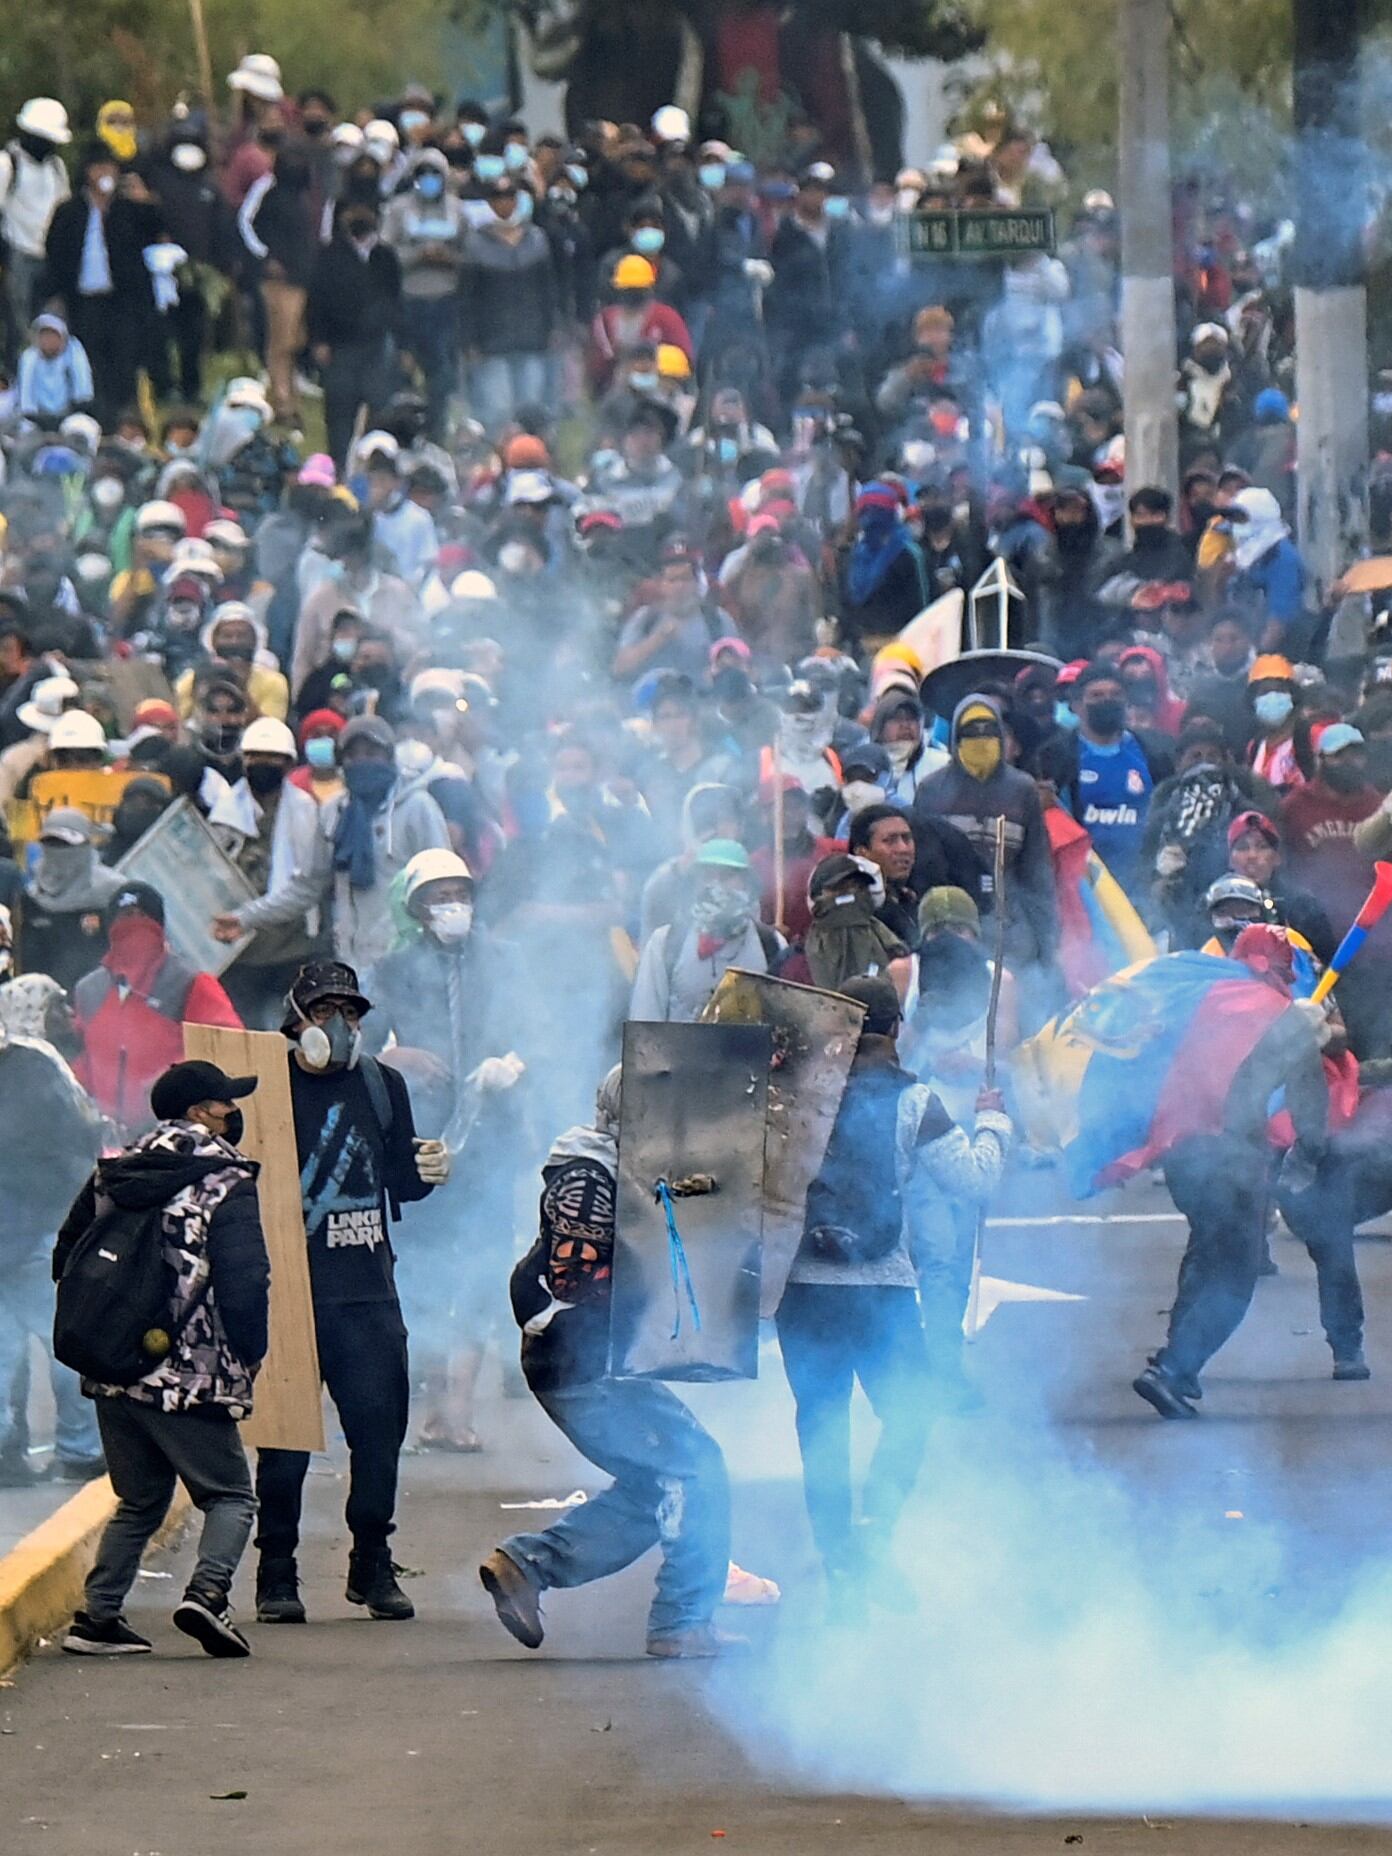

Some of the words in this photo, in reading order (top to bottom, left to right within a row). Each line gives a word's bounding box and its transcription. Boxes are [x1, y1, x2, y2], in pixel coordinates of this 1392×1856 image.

[989, 217, 1045, 244] TARQUI
[1084, 803, 1138, 825] bwin
[1305, 819, 1356, 848] AMERI
[326, 1224, 384, 1253] PARK
